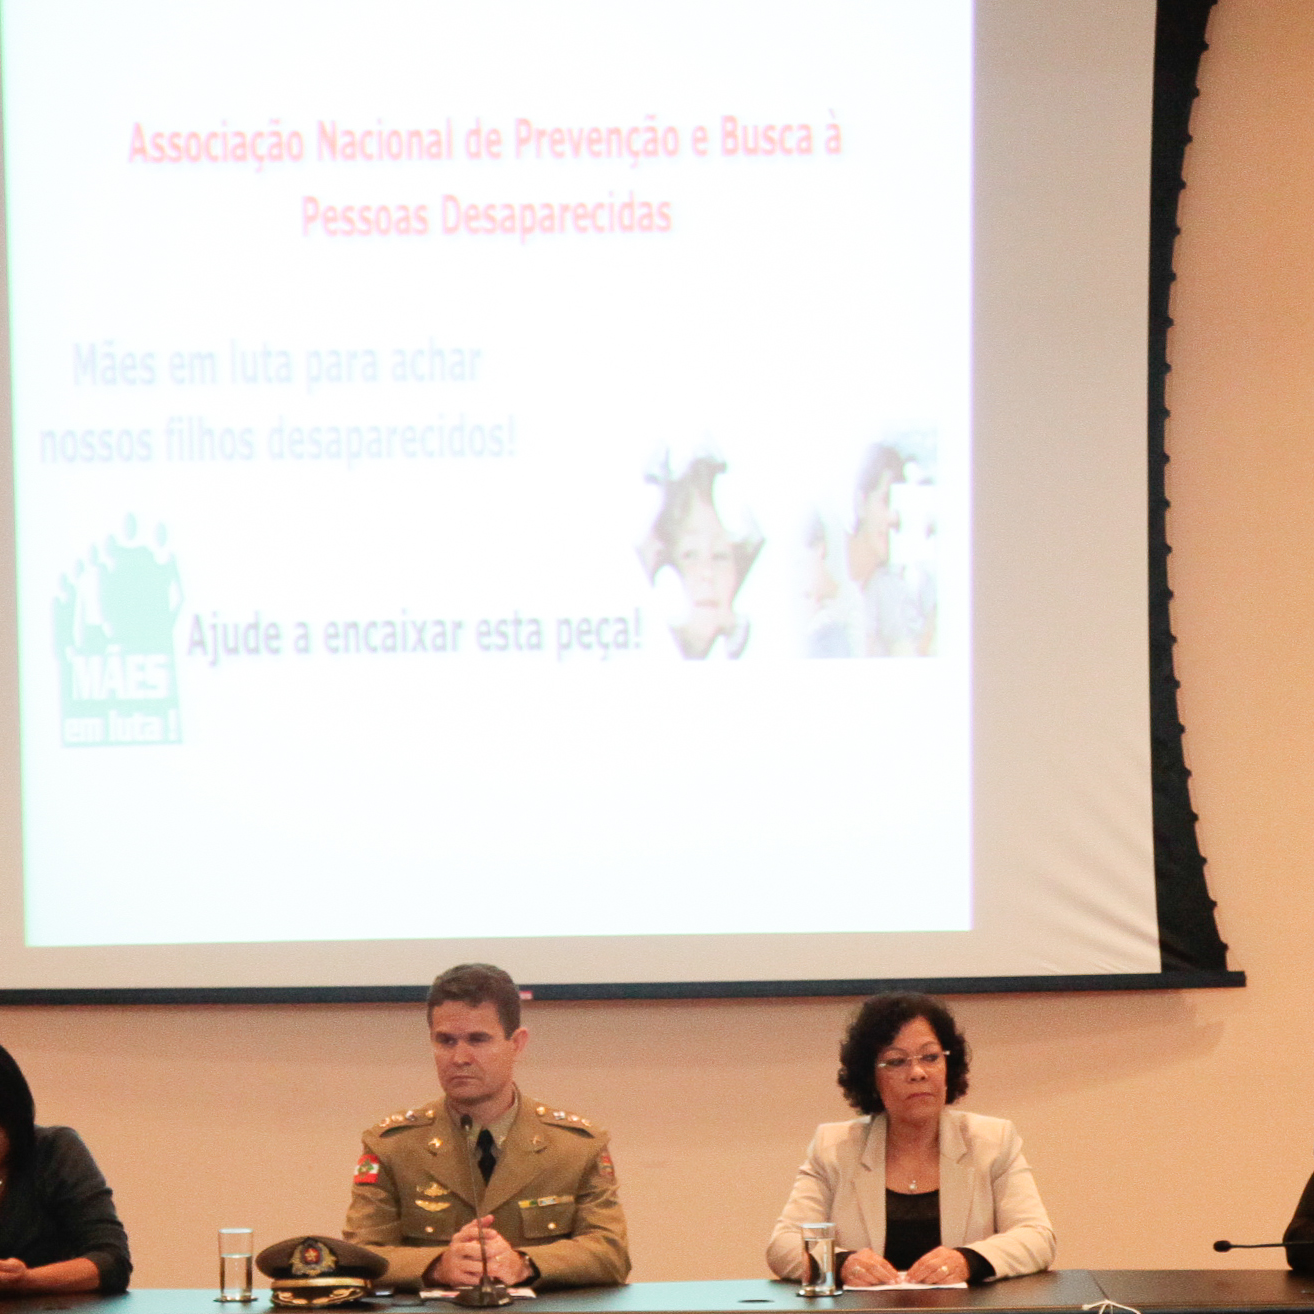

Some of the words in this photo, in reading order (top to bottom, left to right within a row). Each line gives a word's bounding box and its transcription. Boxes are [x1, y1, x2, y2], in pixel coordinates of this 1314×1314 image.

[128, 119, 304, 172] Associação
[317, 119, 453, 163] Nacional
[464, 119, 504, 160] de
[514, 115, 680, 169] Prevenção
[692, 126, 708, 159] e
[721, 115, 814, 157] Busca
[825, 108, 842, 156] à
[301, 195, 430, 238] Pessoas
[442, 190, 672, 244] Desaparecidas
[71, 339, 157, 387] Mães
[169, 351, 218, 385] em
[229, 339, 292, 385] luta
[306, 341, 379, 394] para
[391, 337, 484, 383] achar
[39, 425, 153, 464] nossos
[165, 417, 257, 463] filhos
[266, 413, 518, 470] desaparecidos!
[188, 611, 284, 668] Ajude
[292, 624, 310, 655] a
[323, 610, 464, 654] encaixar
[475, 613, 543, 651] esta
[556, 608, 642, 662] peça!
[71, 644, 168, 701] MÃES
[64, 715, 103, 743] em
[110, 712, 160, 741] luta
